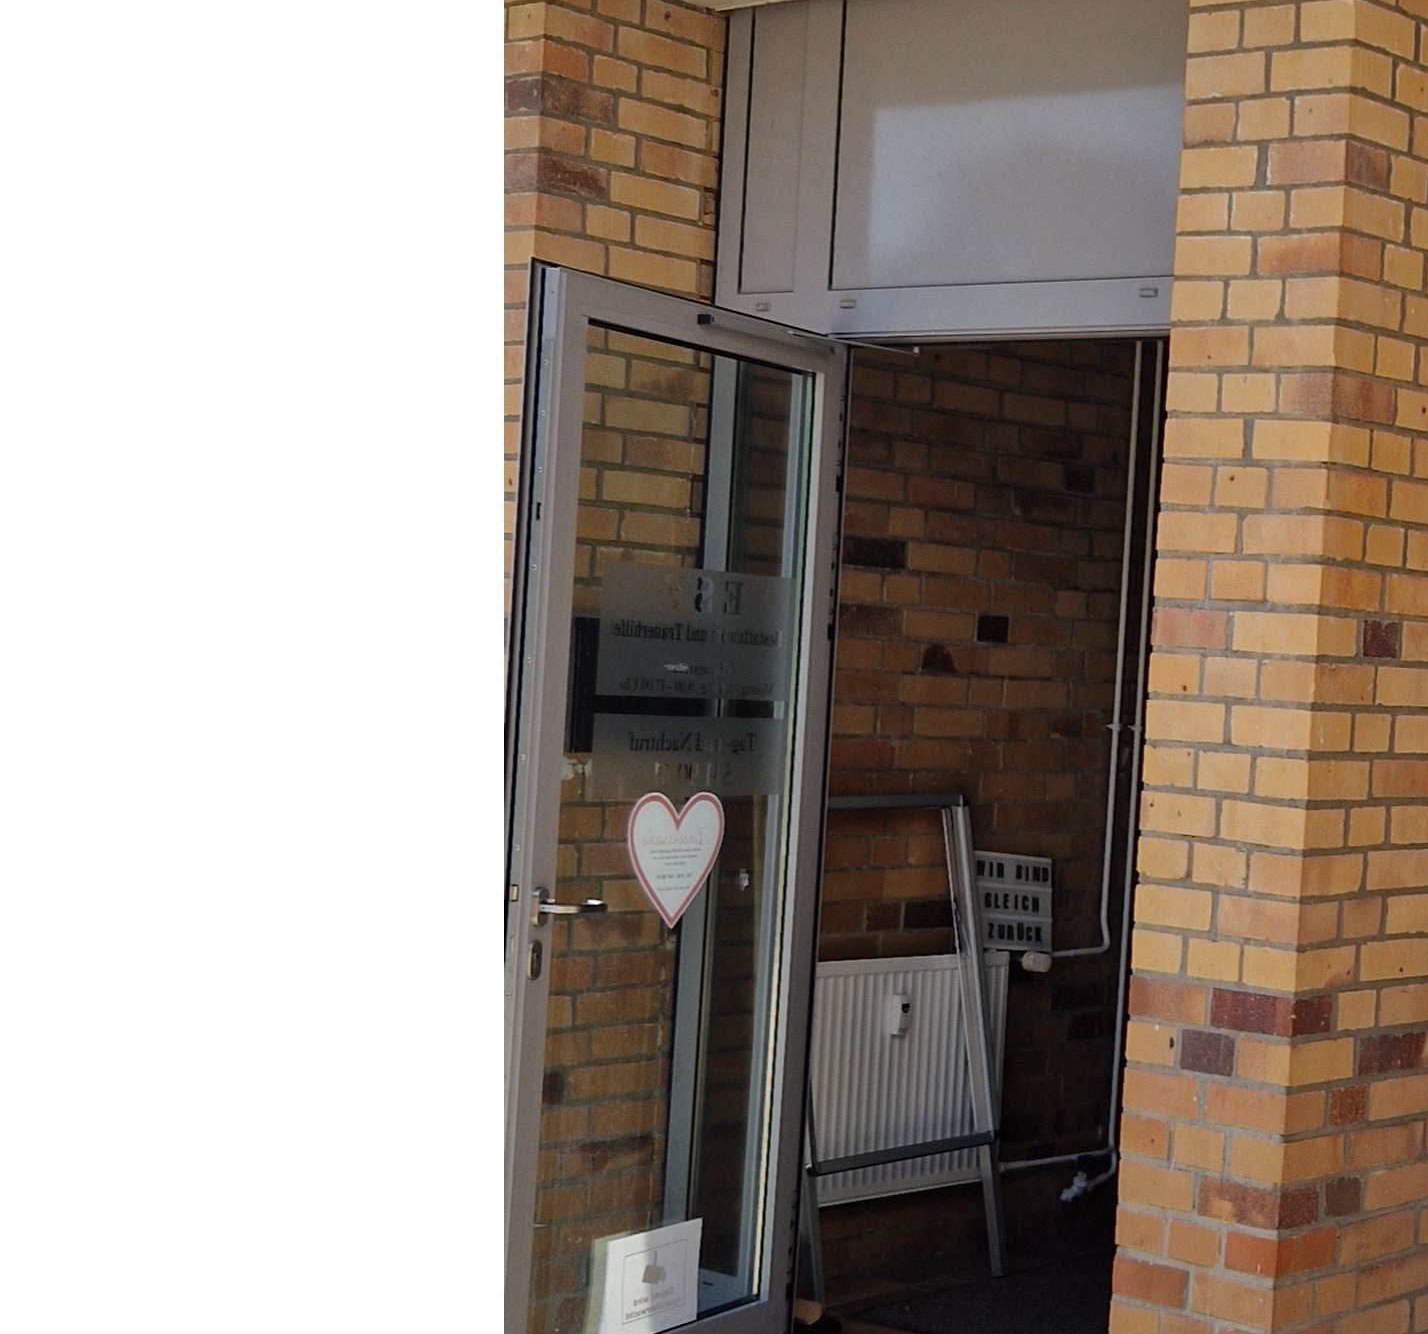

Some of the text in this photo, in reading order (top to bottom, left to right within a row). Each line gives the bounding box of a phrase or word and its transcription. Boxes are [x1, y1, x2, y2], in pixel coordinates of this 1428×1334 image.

[976, 860, 1050, 883] WIR SIND
[984, 891, 1040, 913] GLEICH
[987, 921, 1043, 943] ZURÜCK
